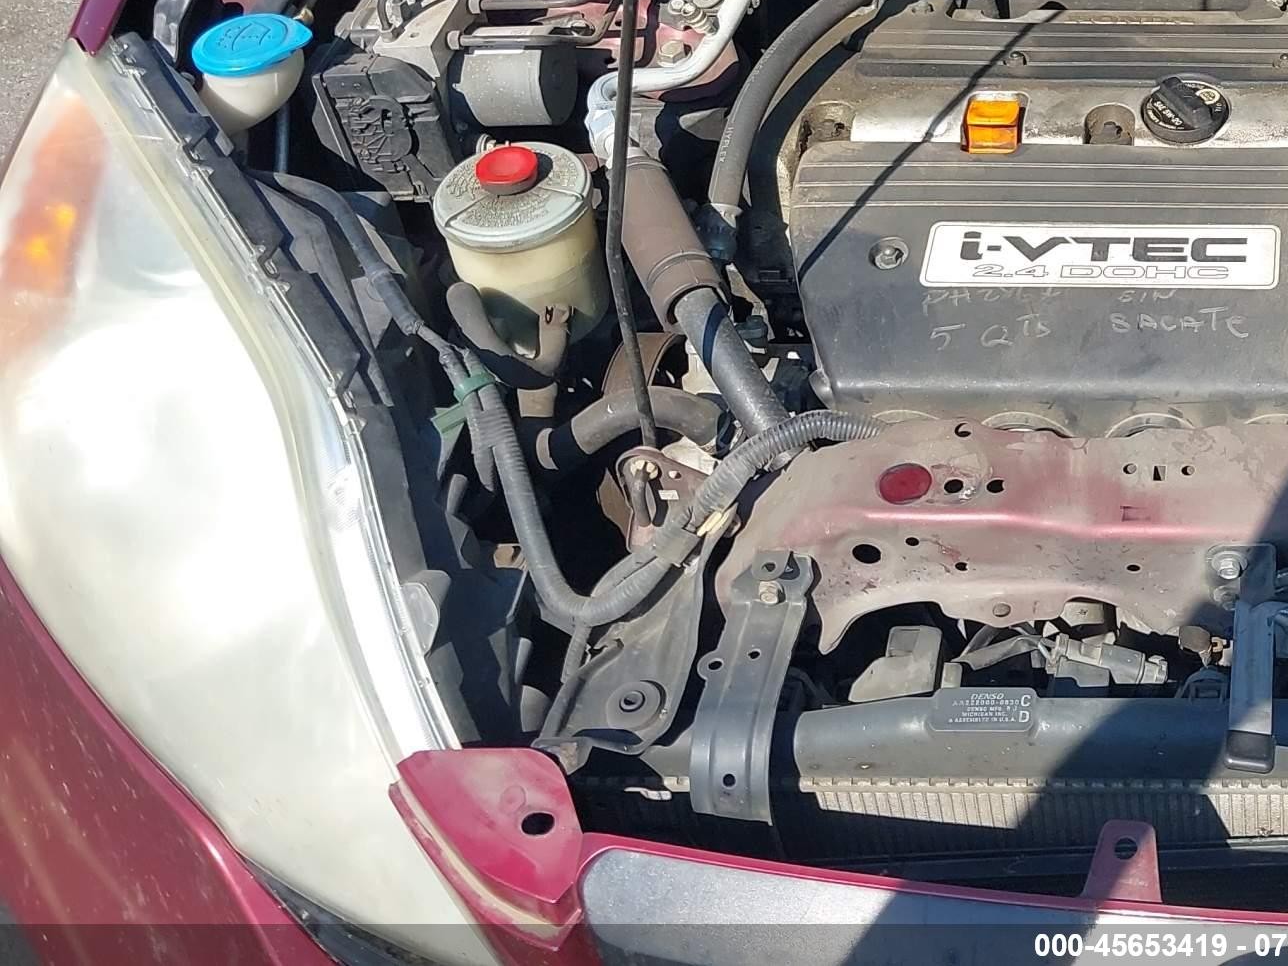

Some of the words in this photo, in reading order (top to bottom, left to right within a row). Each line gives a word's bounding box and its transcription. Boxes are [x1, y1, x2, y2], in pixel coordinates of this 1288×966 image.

[959, 230, 1248, 263] i-VTEC
[973, 264, 1049, 279] 2.4
[1059, 265, 1230, 280] DOHC
[1020, 694, 1032, 707] C
[1018, 710, 1031, 723] D
